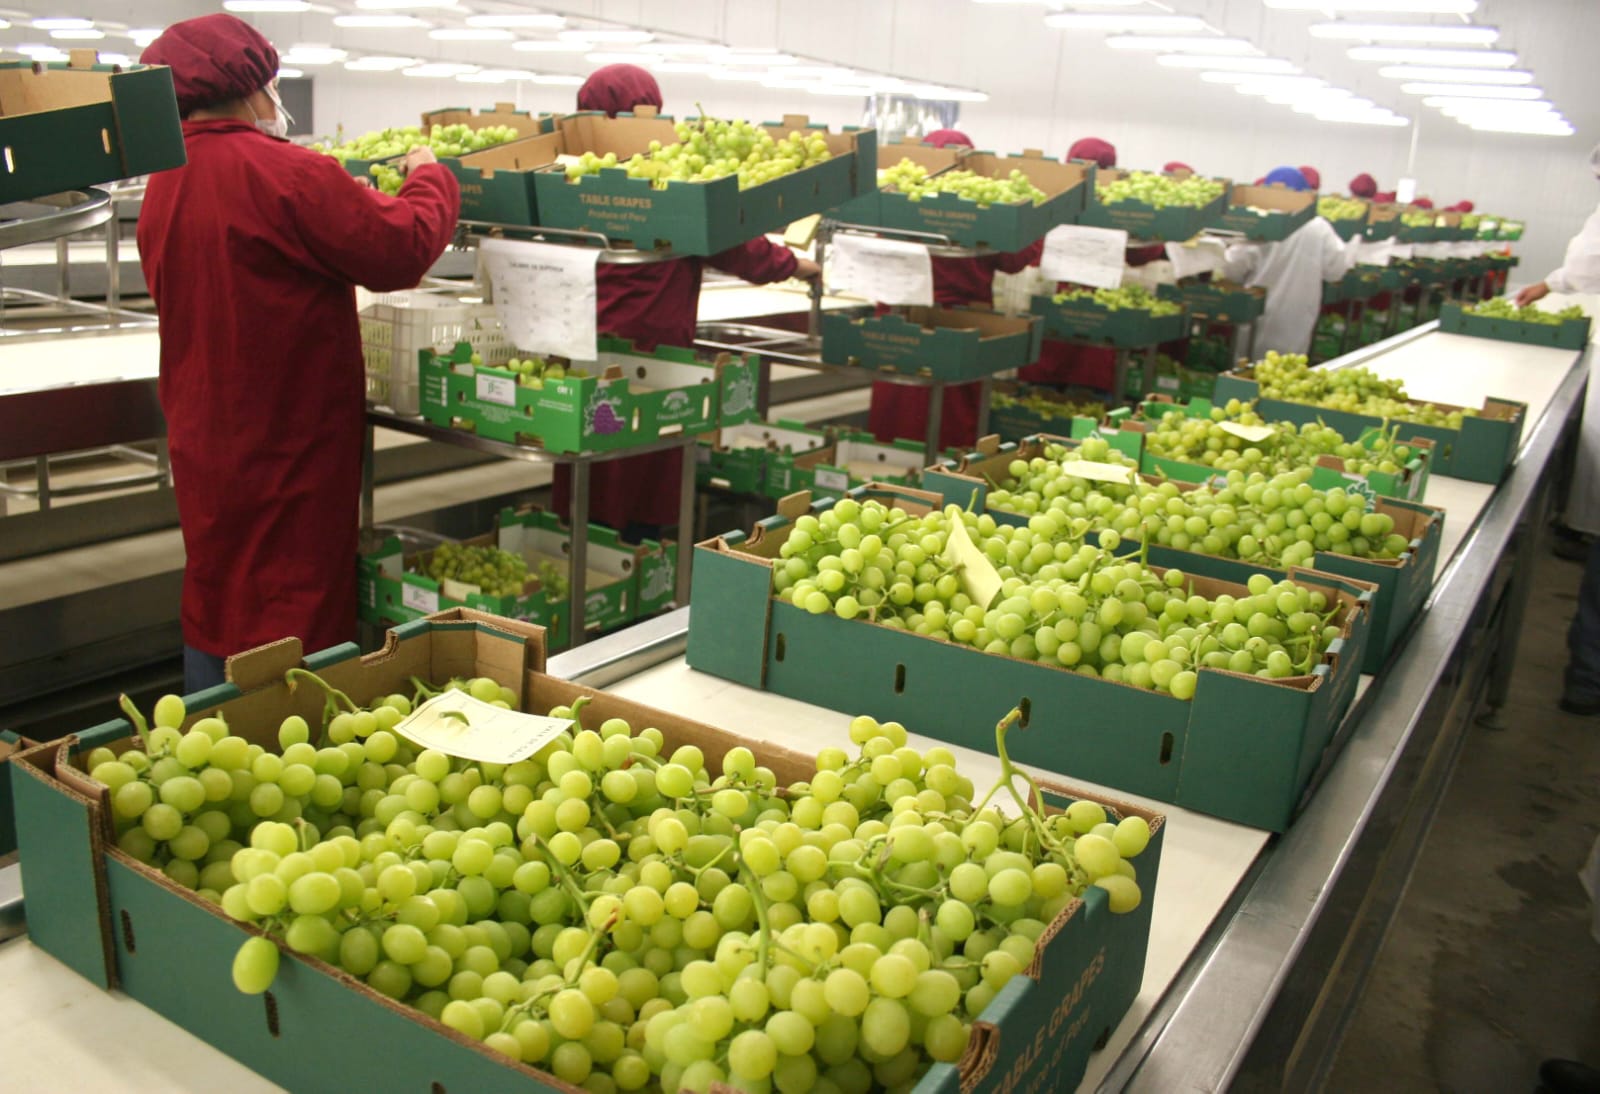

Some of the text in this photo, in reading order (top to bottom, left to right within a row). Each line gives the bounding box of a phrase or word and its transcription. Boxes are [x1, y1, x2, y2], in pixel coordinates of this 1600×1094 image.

[579, 193, 652, 209] TABLE GRAPES
[1049, 946, 1106, 1038] GRAPES
